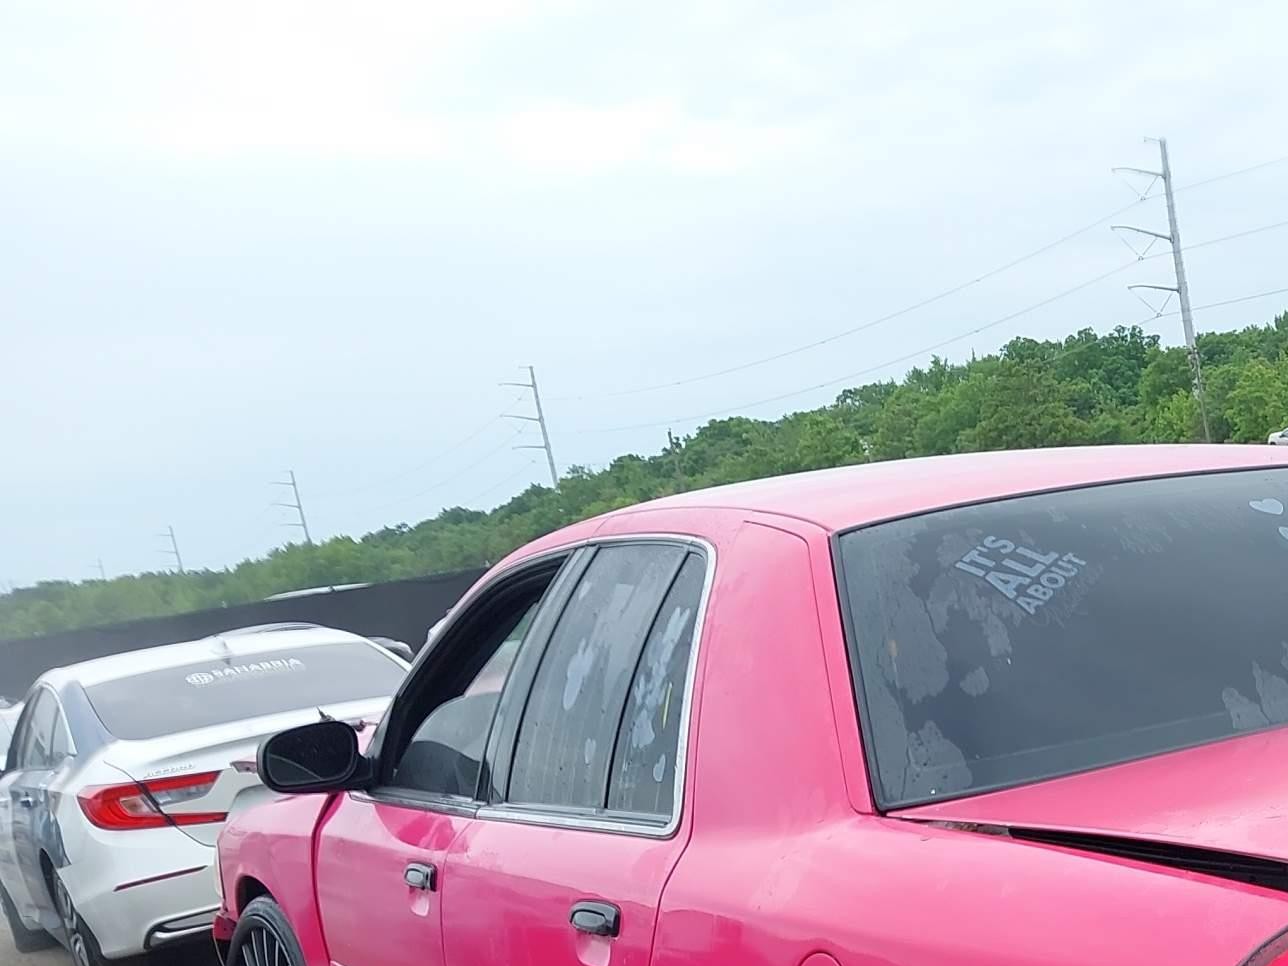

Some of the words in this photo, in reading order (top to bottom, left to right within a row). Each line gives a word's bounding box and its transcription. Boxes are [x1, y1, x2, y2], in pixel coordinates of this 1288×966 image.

[954, 535, 1016, 578] IT'S
[984, 546, 1060, 600] ALL
[1015, 551, 1088, 616] ABOUT
